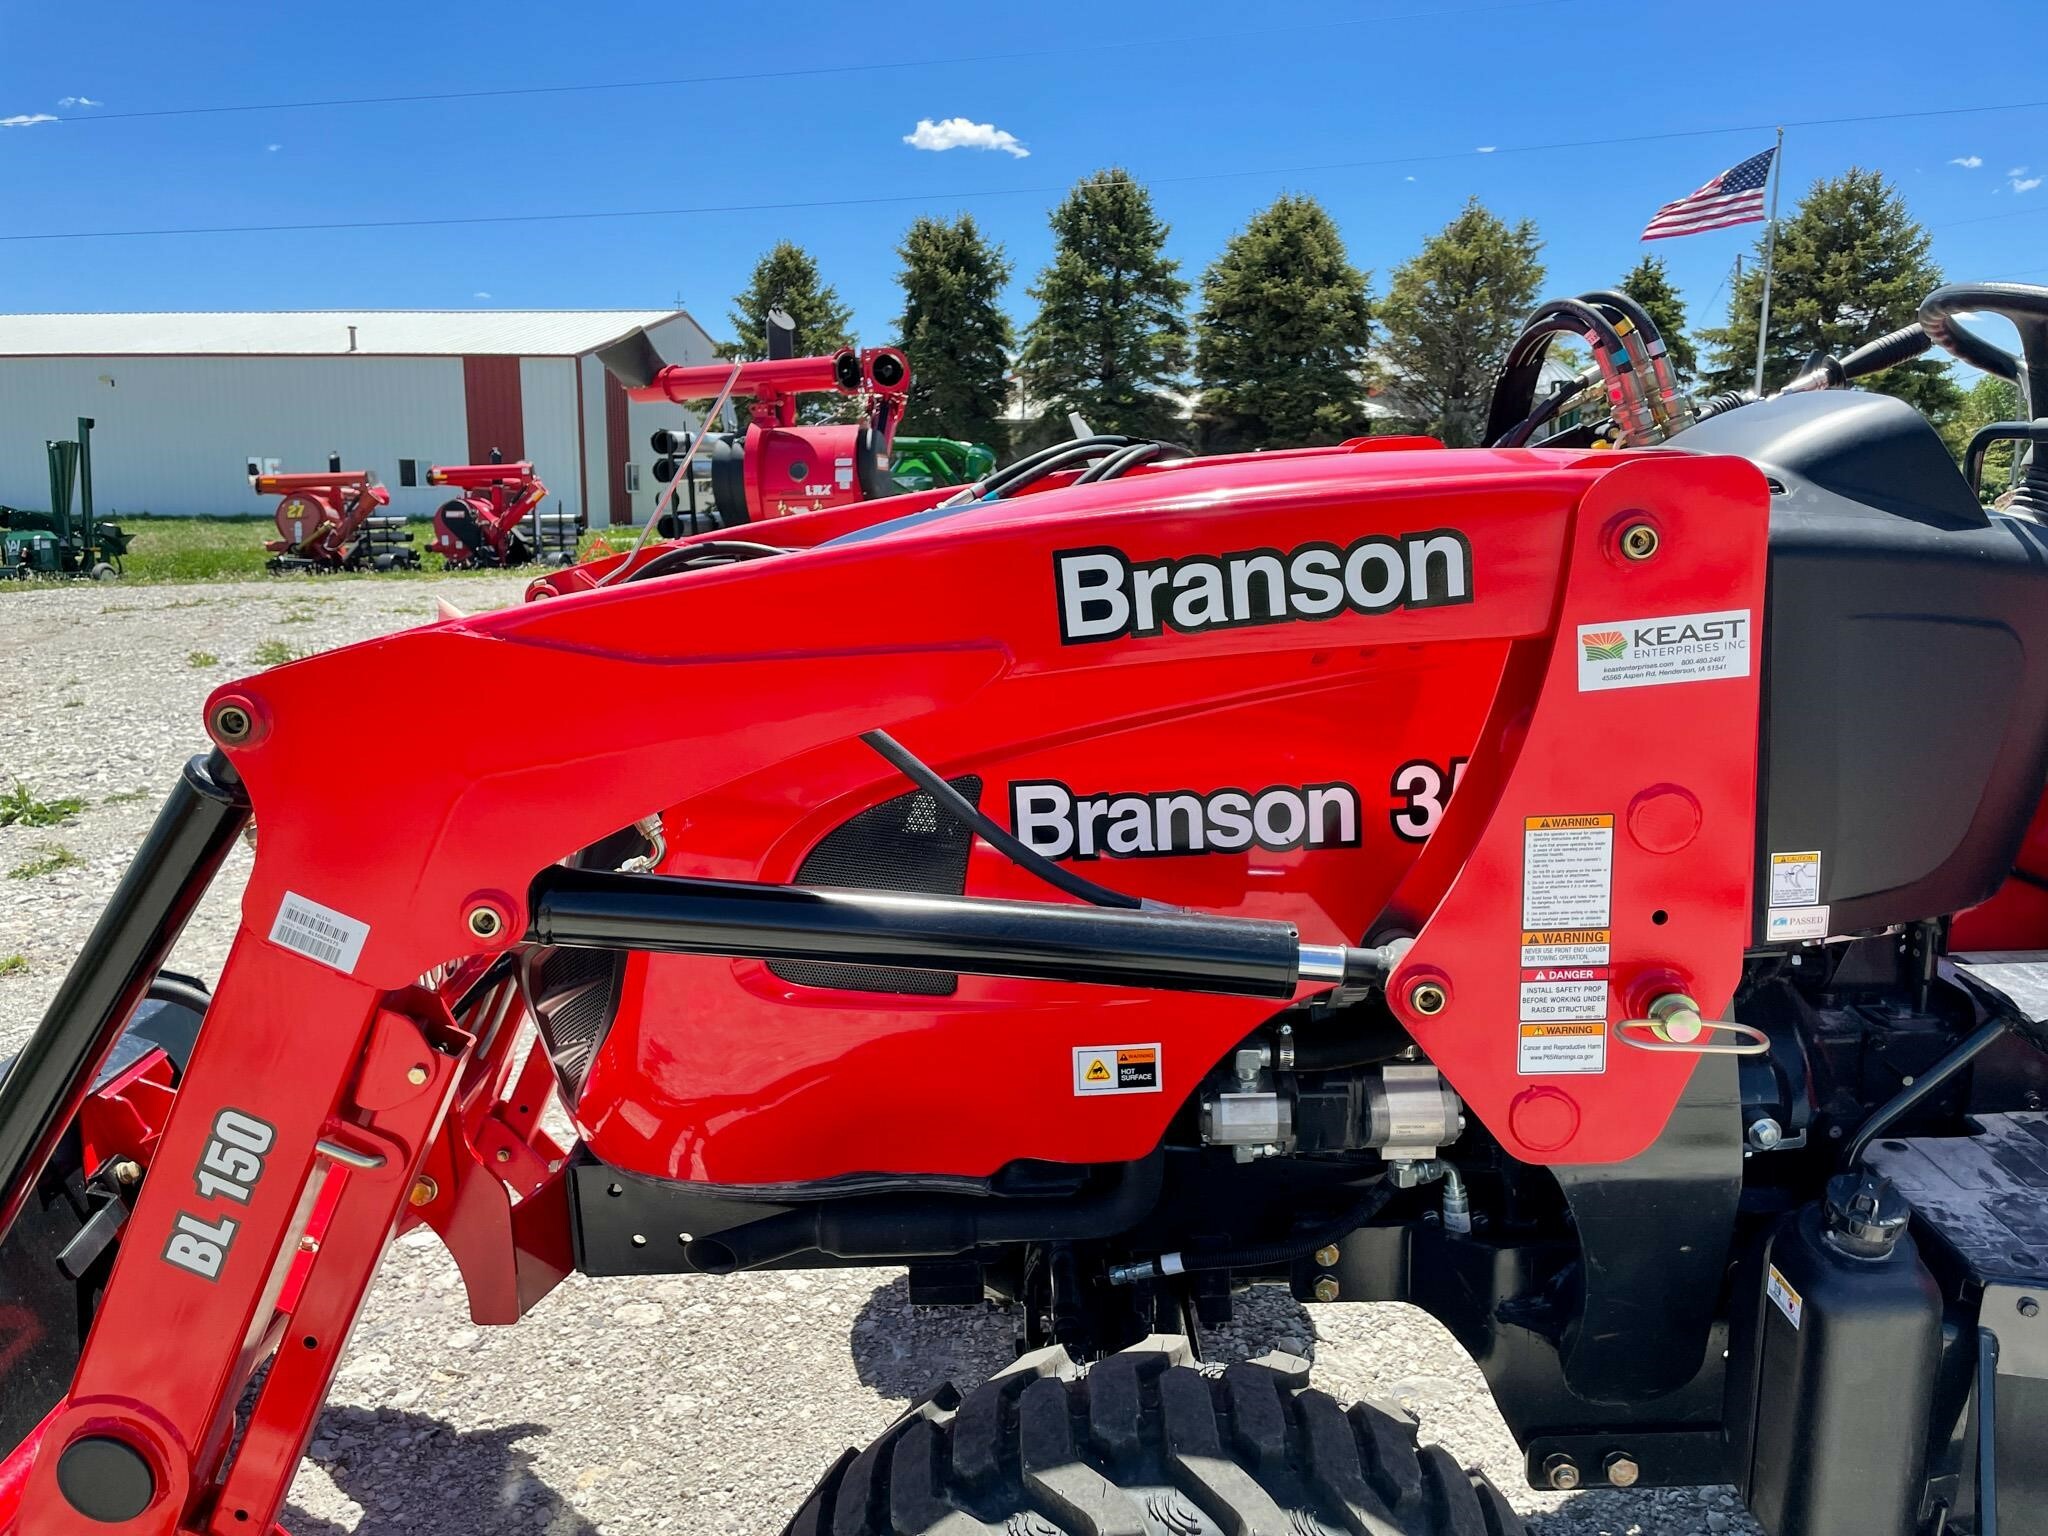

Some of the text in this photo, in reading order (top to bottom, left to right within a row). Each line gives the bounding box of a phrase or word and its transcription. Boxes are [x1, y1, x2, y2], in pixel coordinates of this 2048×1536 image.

[287, 504, 305, 518] 27
[1058, 532, 1468, 640] Branson
[1634, 619, 1746, 647] KEAST
[1634, 640, 1746, 659] ENTERPRISES INC
[1622, 671, 1645, 681] Aspen
[1658, 667, 1697, 677] Henderson,
[1697, 665, 1706, 673] IA
[1013, 762, 1469, 857] Branson 3
[1551, 817, 1600, 827] WARNING
[1789, 916, 1824, 925] PASSED
[1542, 931, 1604, 943] WARNING
[1524, 947, 1542, 955] NEVER
[1554, 946, 1572, 954] FRONT
[1586, 945, 1607, 953] LOADER
[1549, 969, 1594, 980] DANGER
[1583, 985, 1602, 993] PROP
[1522, 996, 1548, 1004] BEFORE
[1583, 995, 1606, 1003] UNDER
[1531, 1005, 1596, 1014] RAISED STRUCTURE
[1546, 1025, 1593, 1035] WARNING
[1553, 1043, 1587, 1051] Reproductive
[1120, 1073, 1152, 1081] SURFACE
[164, 1109, 275, 1279] BL 150
